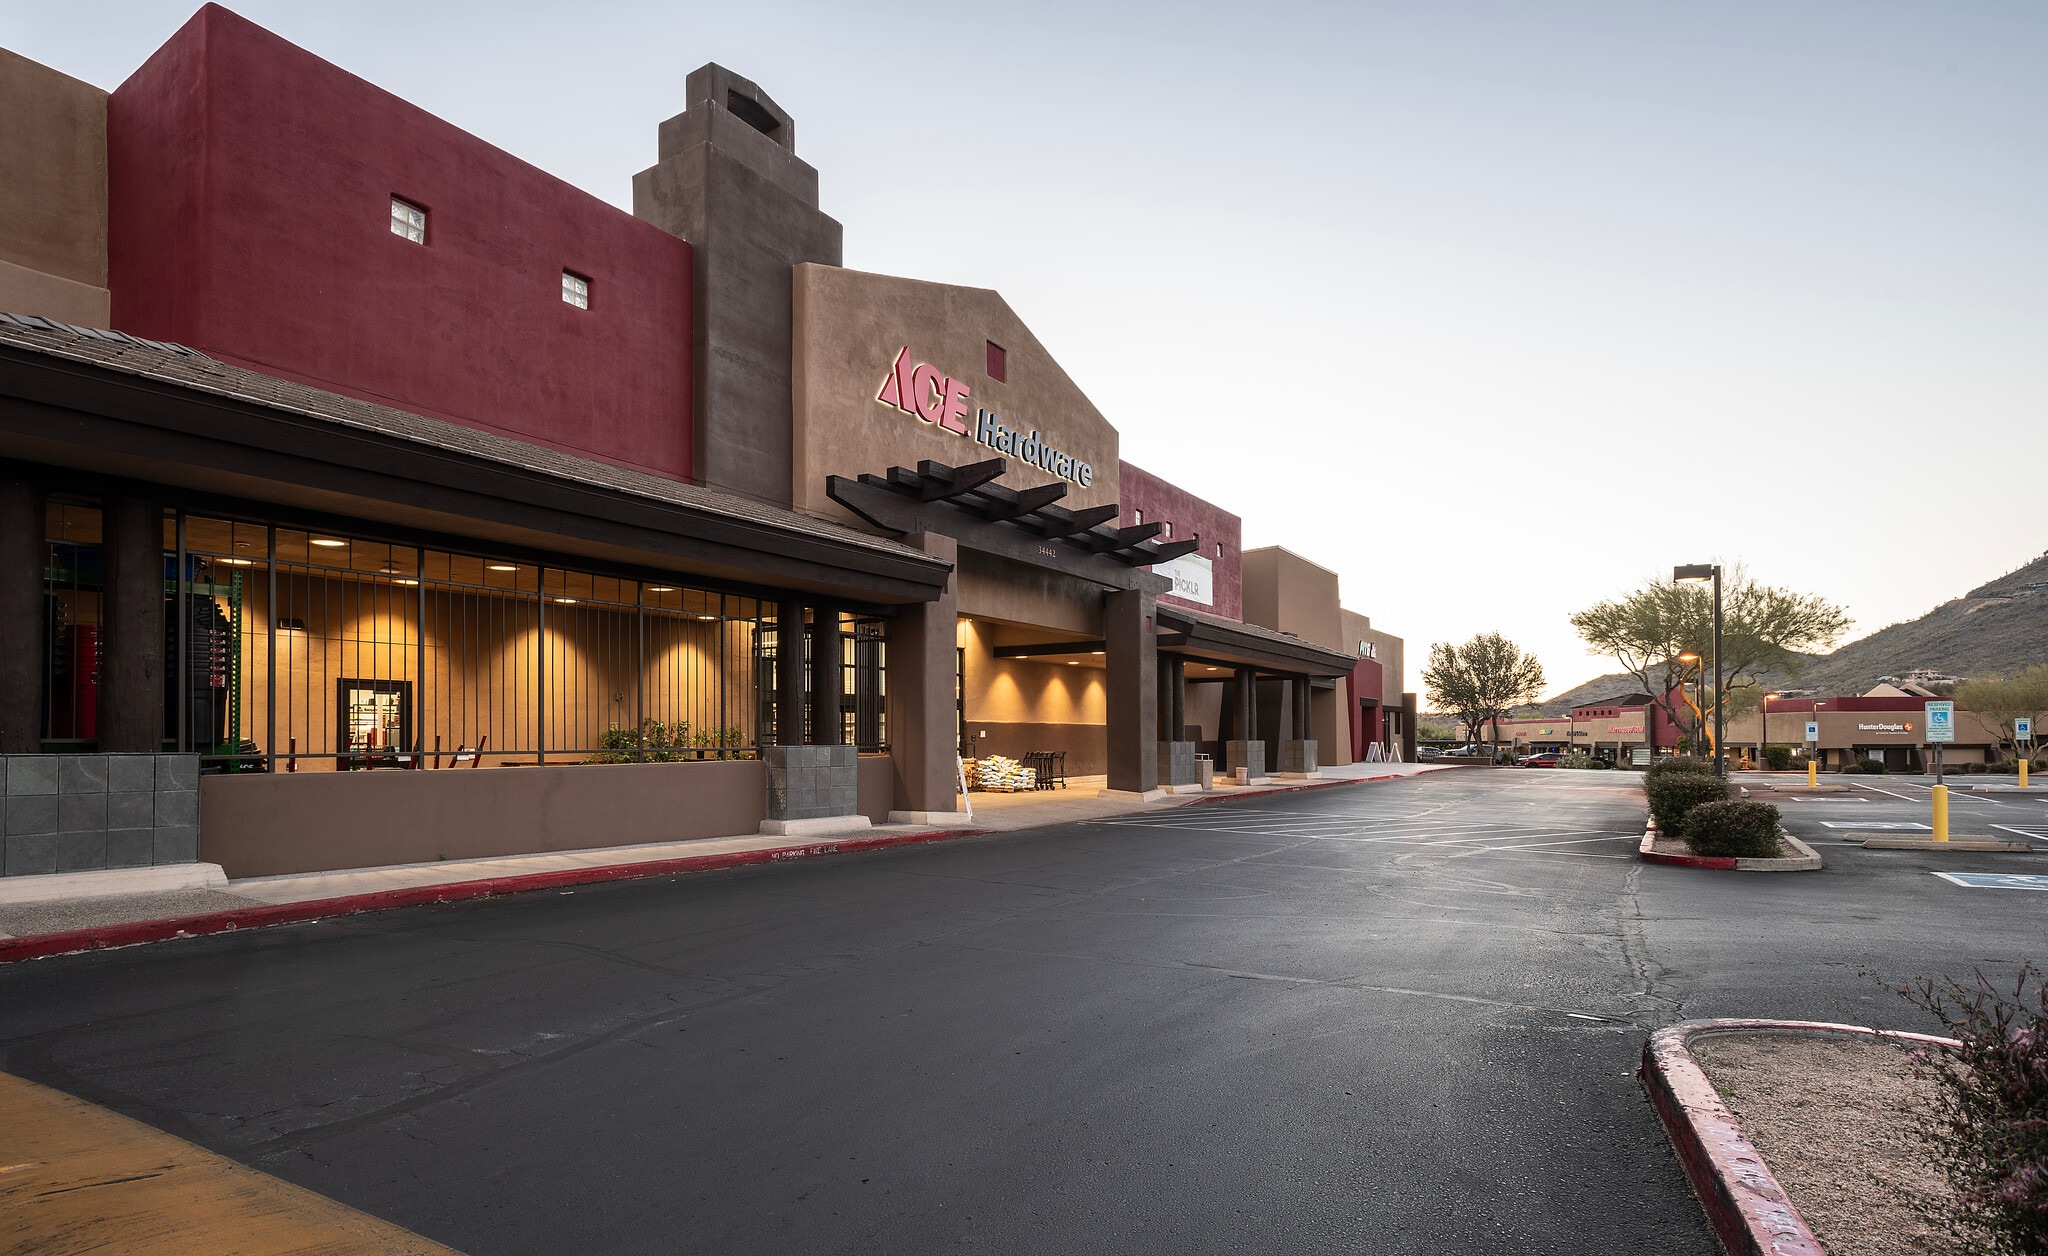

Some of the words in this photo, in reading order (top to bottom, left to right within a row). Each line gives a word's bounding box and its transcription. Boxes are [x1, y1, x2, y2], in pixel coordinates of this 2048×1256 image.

[876, 345, 971, 436] ACE
[976, 408, 1093, 488] Hardware
[1038, 545, 1056, 558] 34442
[1174, 576, 1199, 596] PICKLR
[809, 846, 821, 854] FIRE
[823, 844, 838, 853] LANE
